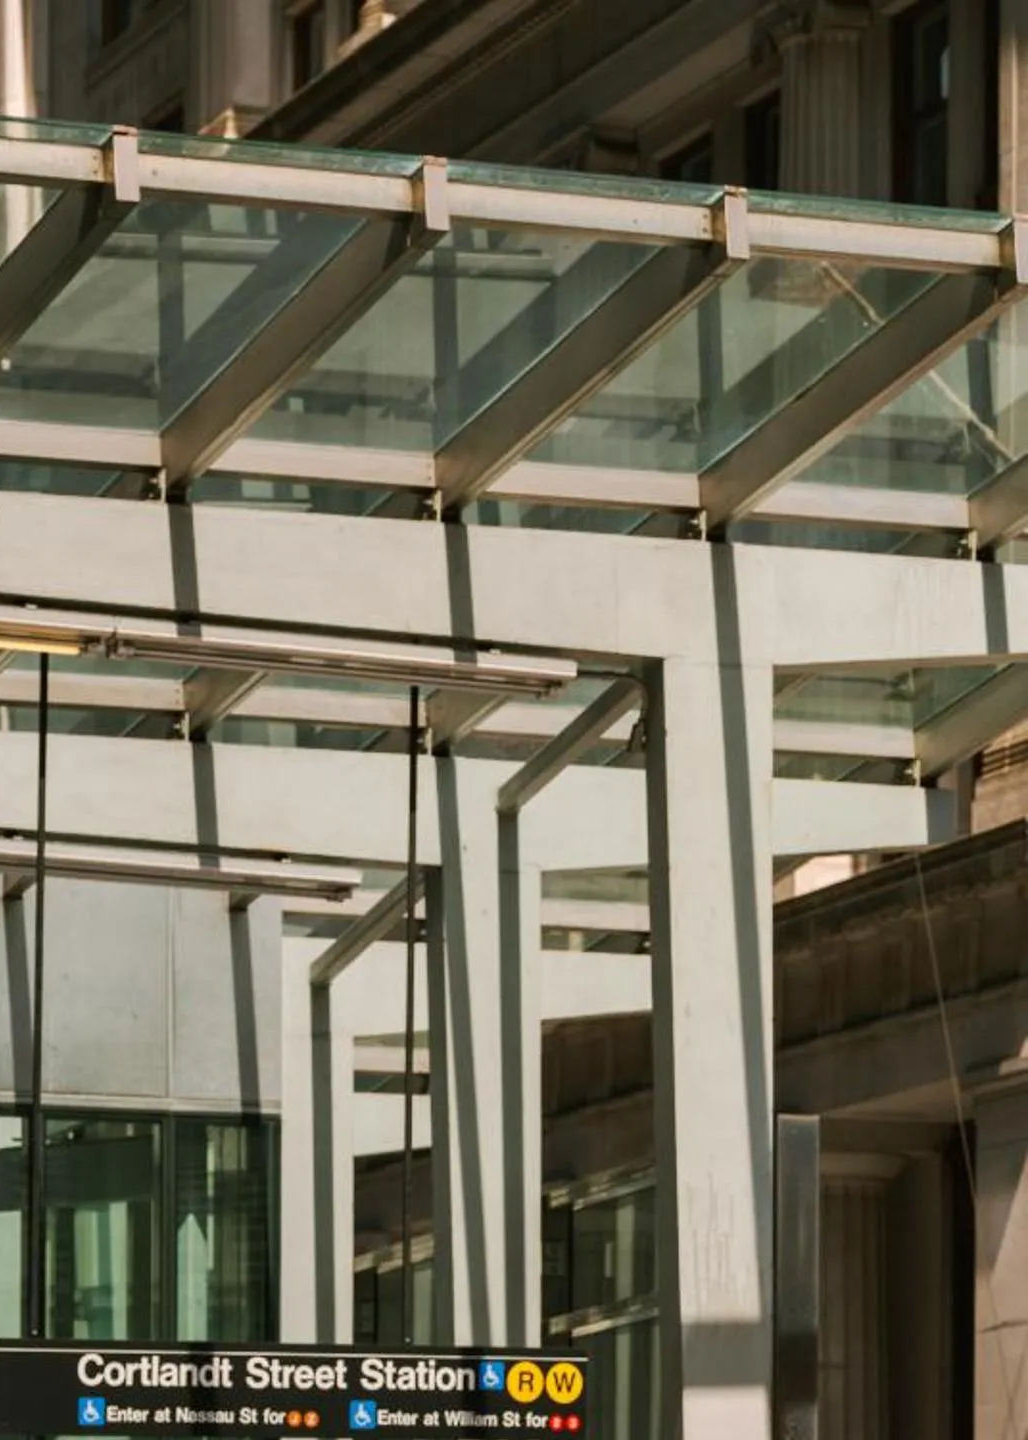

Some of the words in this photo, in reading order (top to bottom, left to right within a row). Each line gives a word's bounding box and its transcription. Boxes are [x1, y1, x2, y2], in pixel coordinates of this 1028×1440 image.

[77, 1353, 233, 1388] Cortlandt
[245, 1356, 348, 1390] Street
[360, 1357, 475, 1391] Station
[106, 1405, 149, 1423] Enter
[154, 1407, 171, 1423] at
[175, 1406, 234, 1424] Nassau
[239, 1407, 258, 1424] St
[263, 1407, 286, 1424] for
[377, 1409, 419, 1426] Enter
[423, 1411, 439, 1427] at
[502, 1410, 520, 1428] St
[526, 1411, 549, 1428] for
